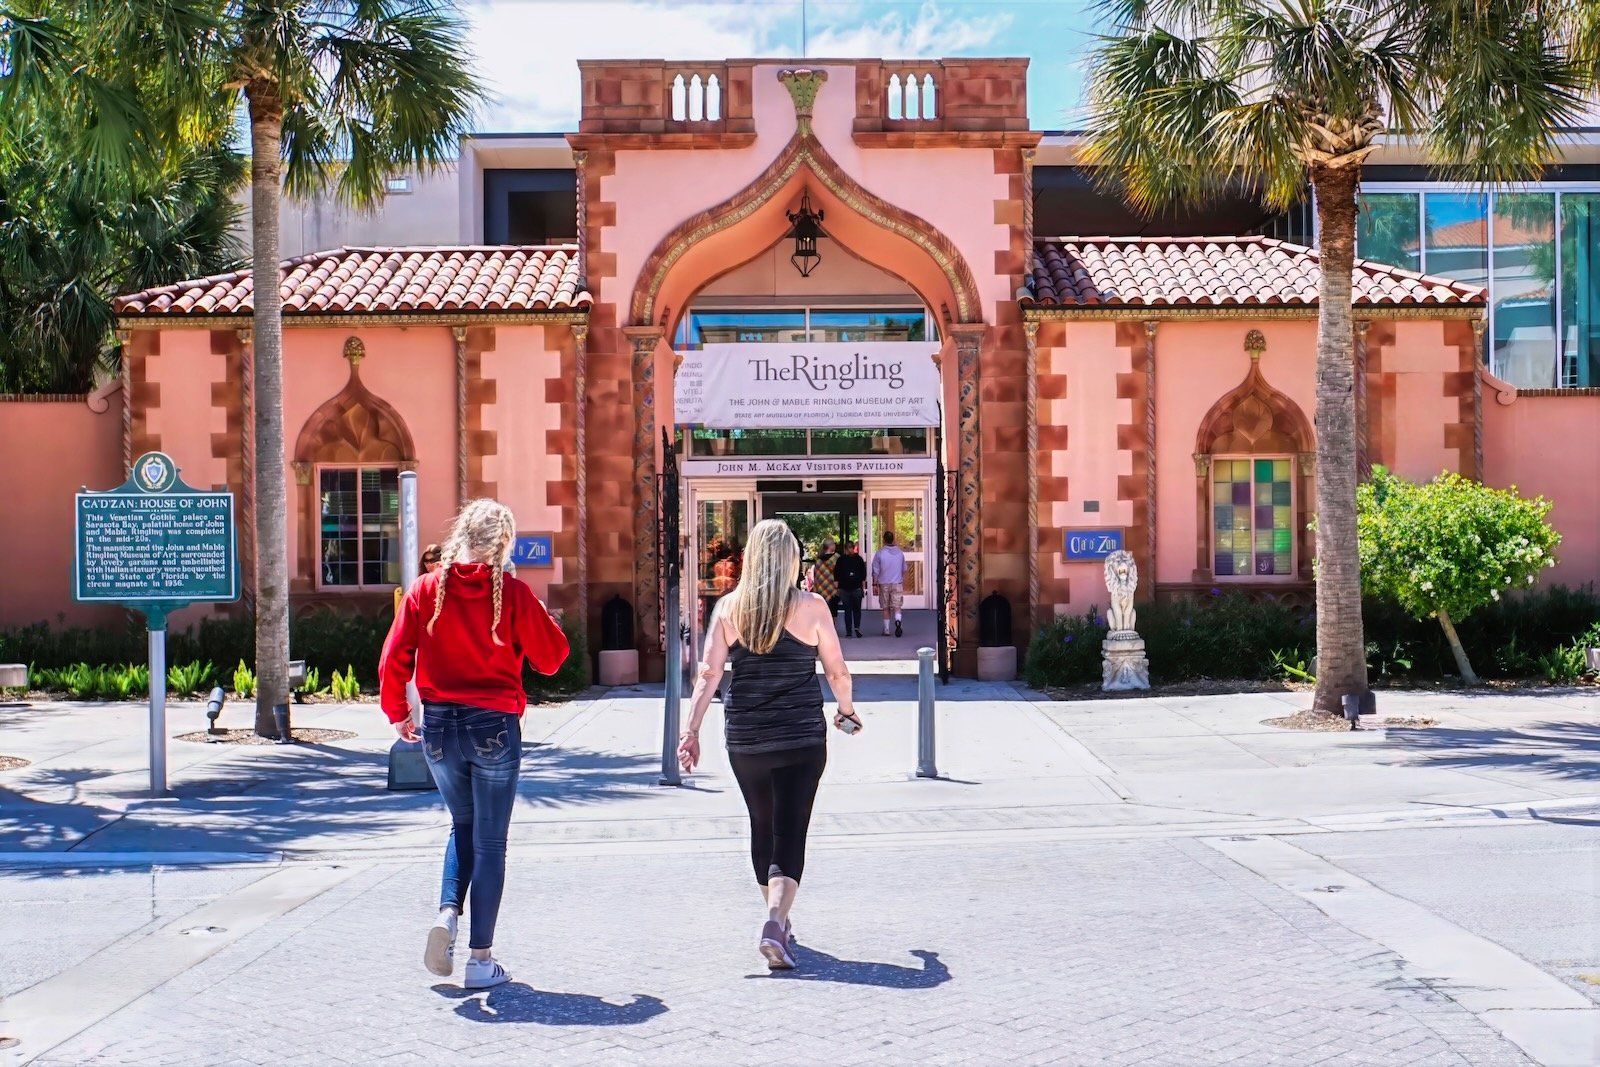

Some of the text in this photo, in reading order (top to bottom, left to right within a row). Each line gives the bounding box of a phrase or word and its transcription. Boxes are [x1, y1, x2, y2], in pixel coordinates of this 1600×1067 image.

[717, 463, 743, 474] JOHN
[748, 463, 761, 471] M.
[806, 462, 852, 470] VISITORS
[856, 462, 904, 470] PAVILION
[140, 499, 176, 508] HOUSE
[180, 499, 194, 508] OF
[197, 498, 228, 508] JOHN
[183, 513, 208, 522] palace
[142, 520, 172, 529] palatial
[132, 528, 162, 536] Ringling
[186, 528, 224, 536] completed
[86, 552, 118, 560] Ringling
[182, 565, 225, 574] bequeathed
